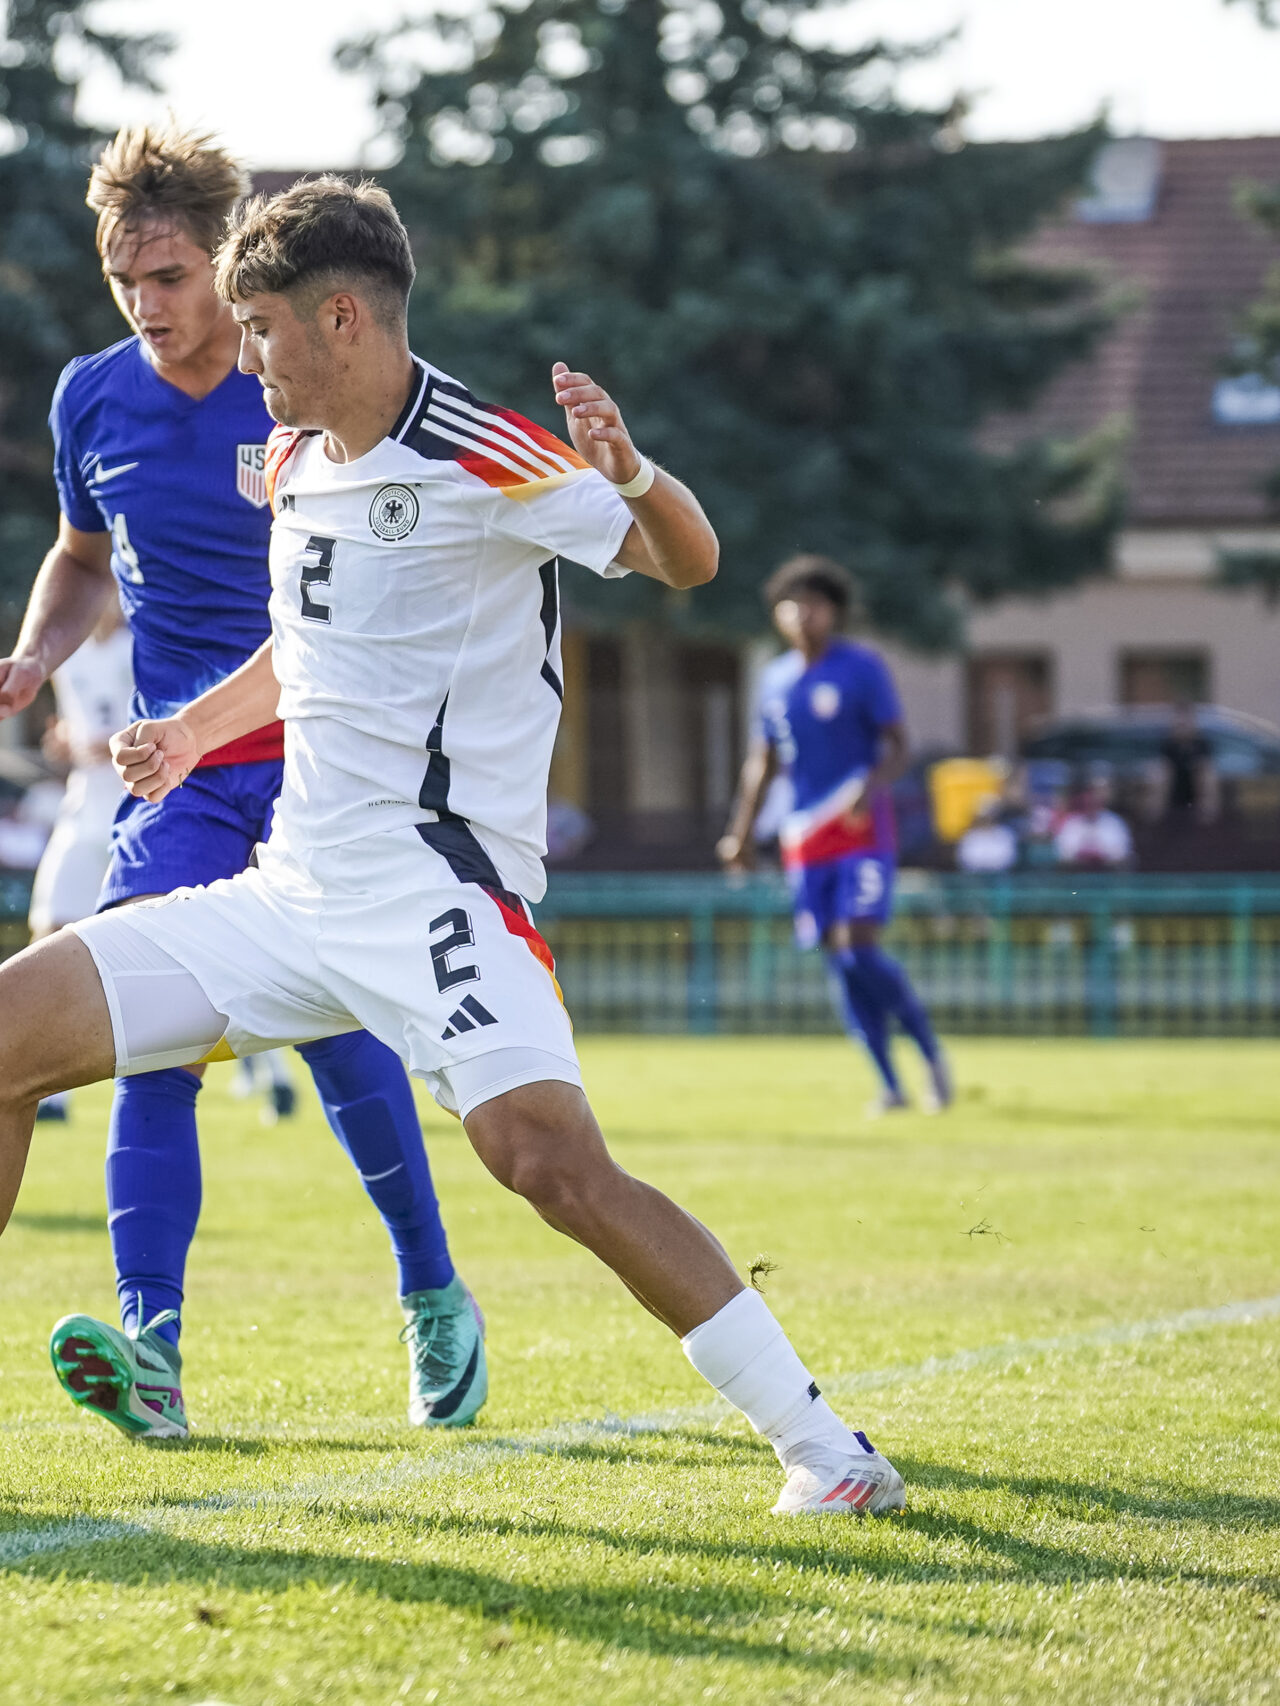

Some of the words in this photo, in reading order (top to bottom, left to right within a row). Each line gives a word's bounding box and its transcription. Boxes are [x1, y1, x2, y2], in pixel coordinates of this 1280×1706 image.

[241, 447, 265, 471] US
[300, 535, 337, 625] 2
[429, 907, 481, 994] 2
[846, 1468, 885, 1484] F50
